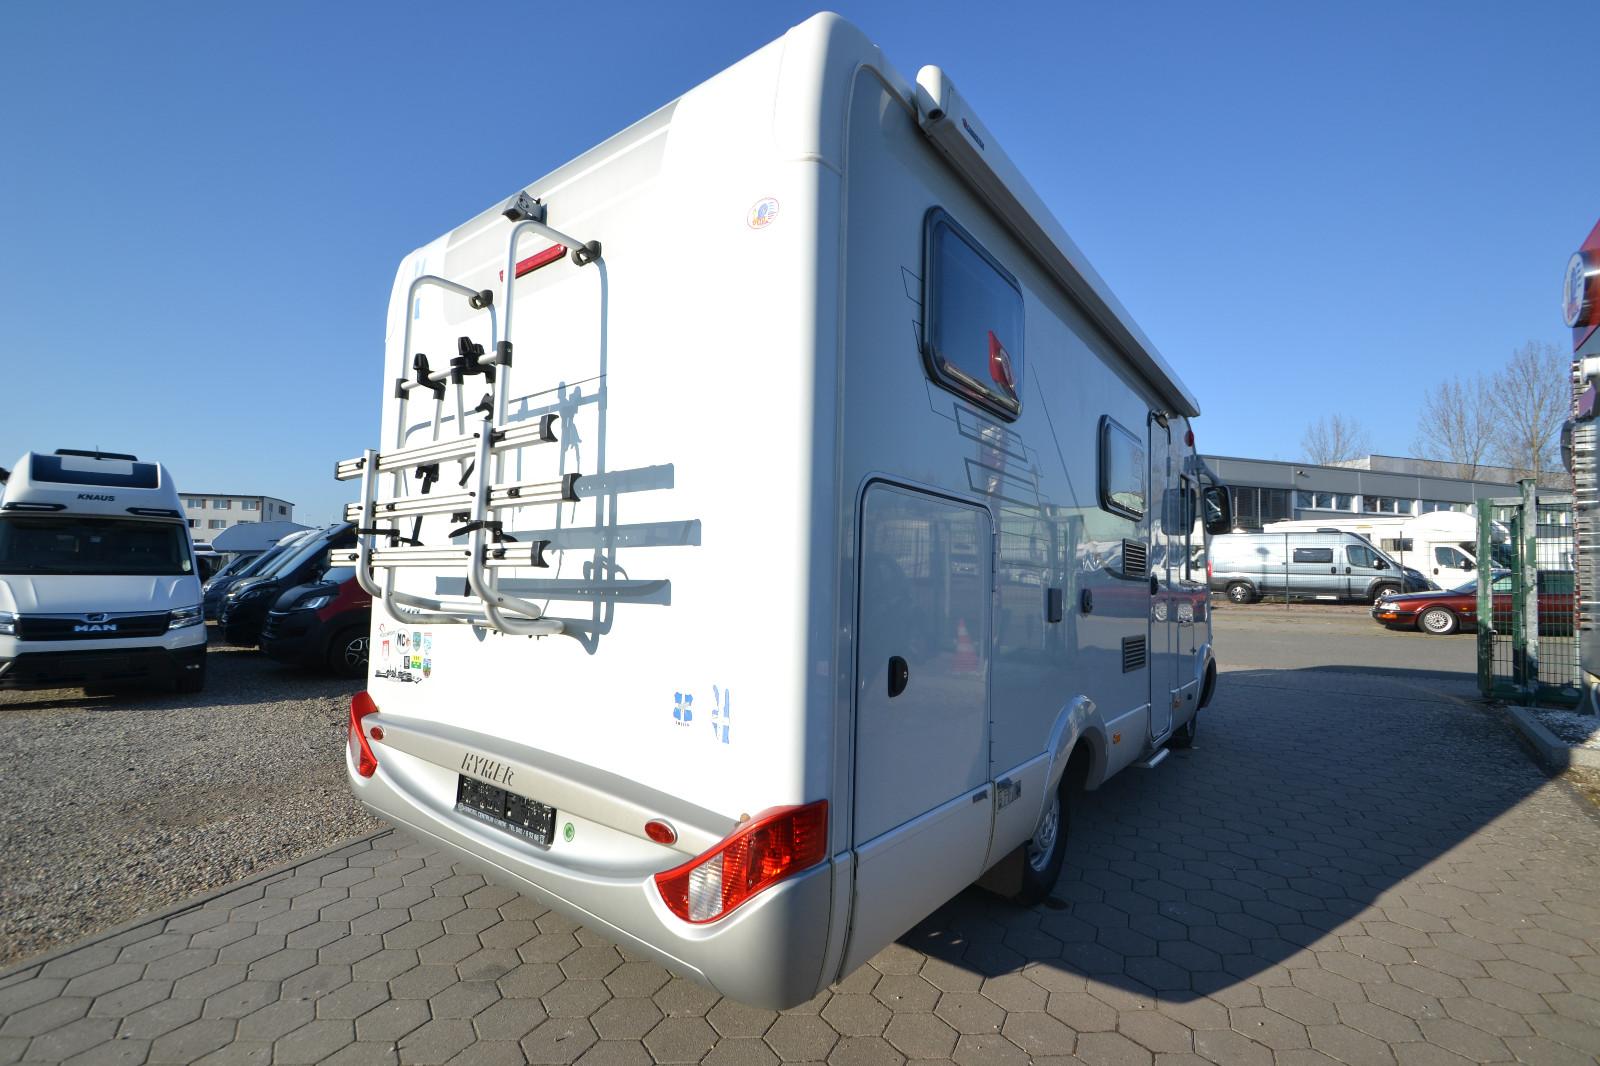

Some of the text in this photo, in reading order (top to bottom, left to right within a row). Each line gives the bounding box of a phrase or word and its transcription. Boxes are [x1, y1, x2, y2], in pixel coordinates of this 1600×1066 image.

[77, 493, 115, 502] KNAUS
[74, 624, 117, 632] MAN
[461, 752, 515, 787] HYMER
